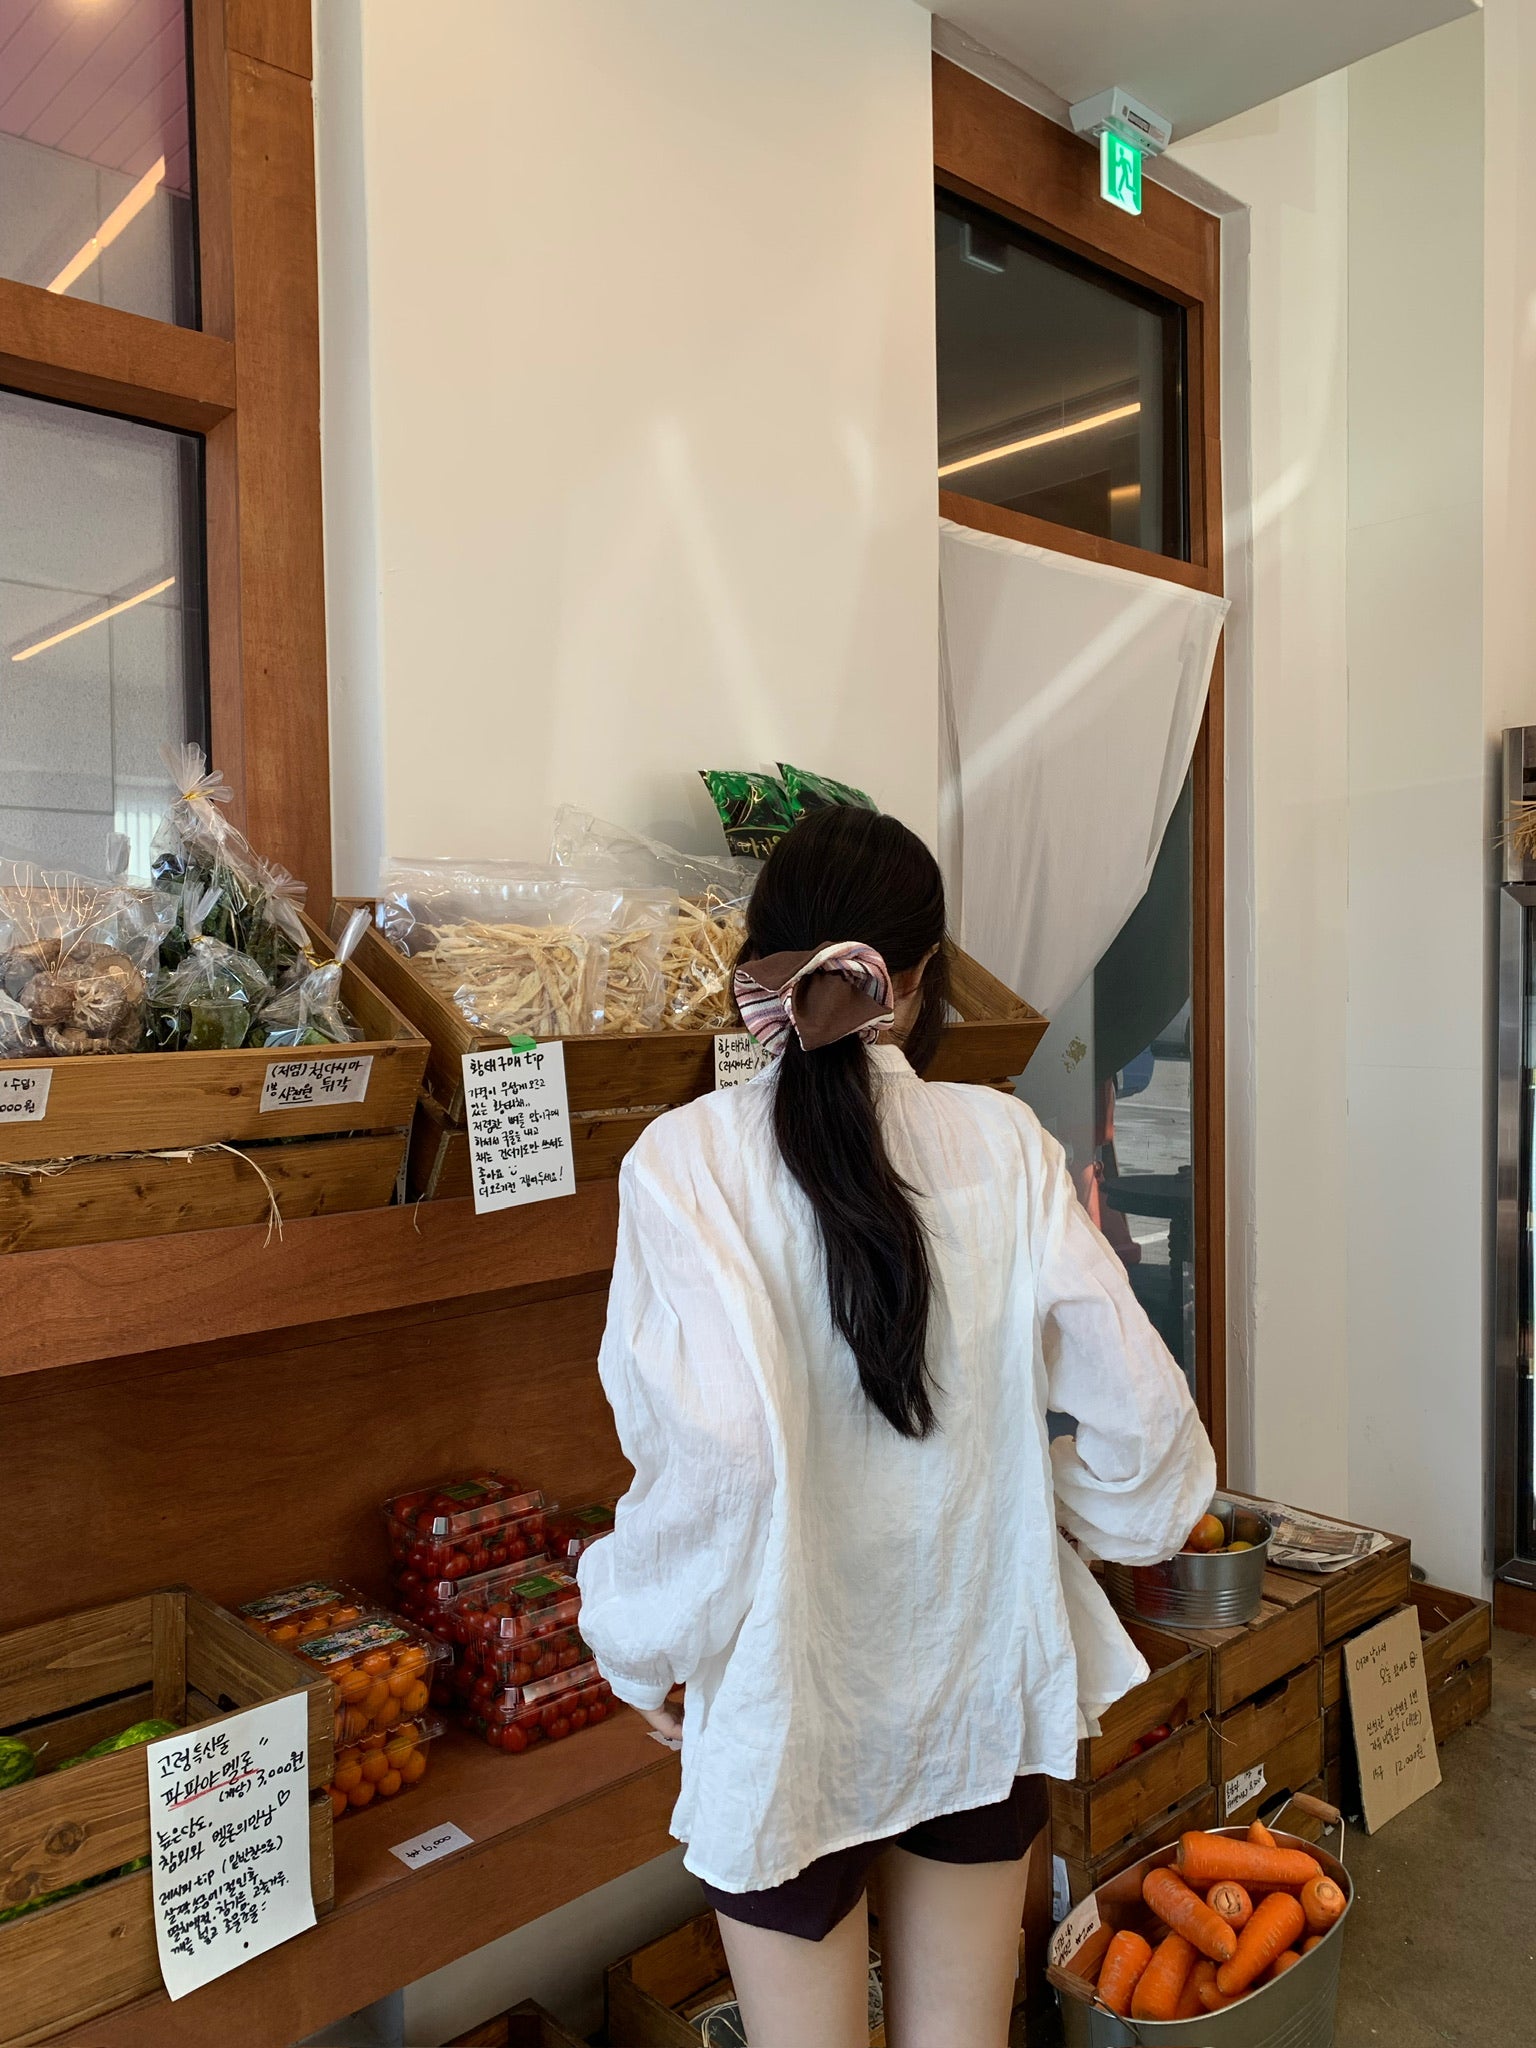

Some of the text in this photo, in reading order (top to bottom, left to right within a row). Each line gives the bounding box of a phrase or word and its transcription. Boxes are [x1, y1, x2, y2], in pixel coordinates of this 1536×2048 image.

[718, 1036, 750, 1058] 황태채
[523, 1052, 544, 1071] tip
[319, 1076, 352, 1092] 튀각
[468, 1086, 497, 1100] 가격이
[470, 1102, 488, 1117] 있는
[507, 1112, 525, 1129] 뼈를
[501, 1129, 521, 1147] 국물을
[523, 1126, 539, 1136] 내고
[475, 1151, 493, 1163] 채는
[498, 1140, 539, 1160] 건더기로만
[477, 1166, 504, 1185] 좋아요
[256, 1750, 306, 1788] 3,000원
[158, 1840, 206, 1874] 참외와
[158, 1879, 192, 1906] 레시피
[193, 1869, 215, 1886] tip
[170, 1936, 195, 1956] 깨를
